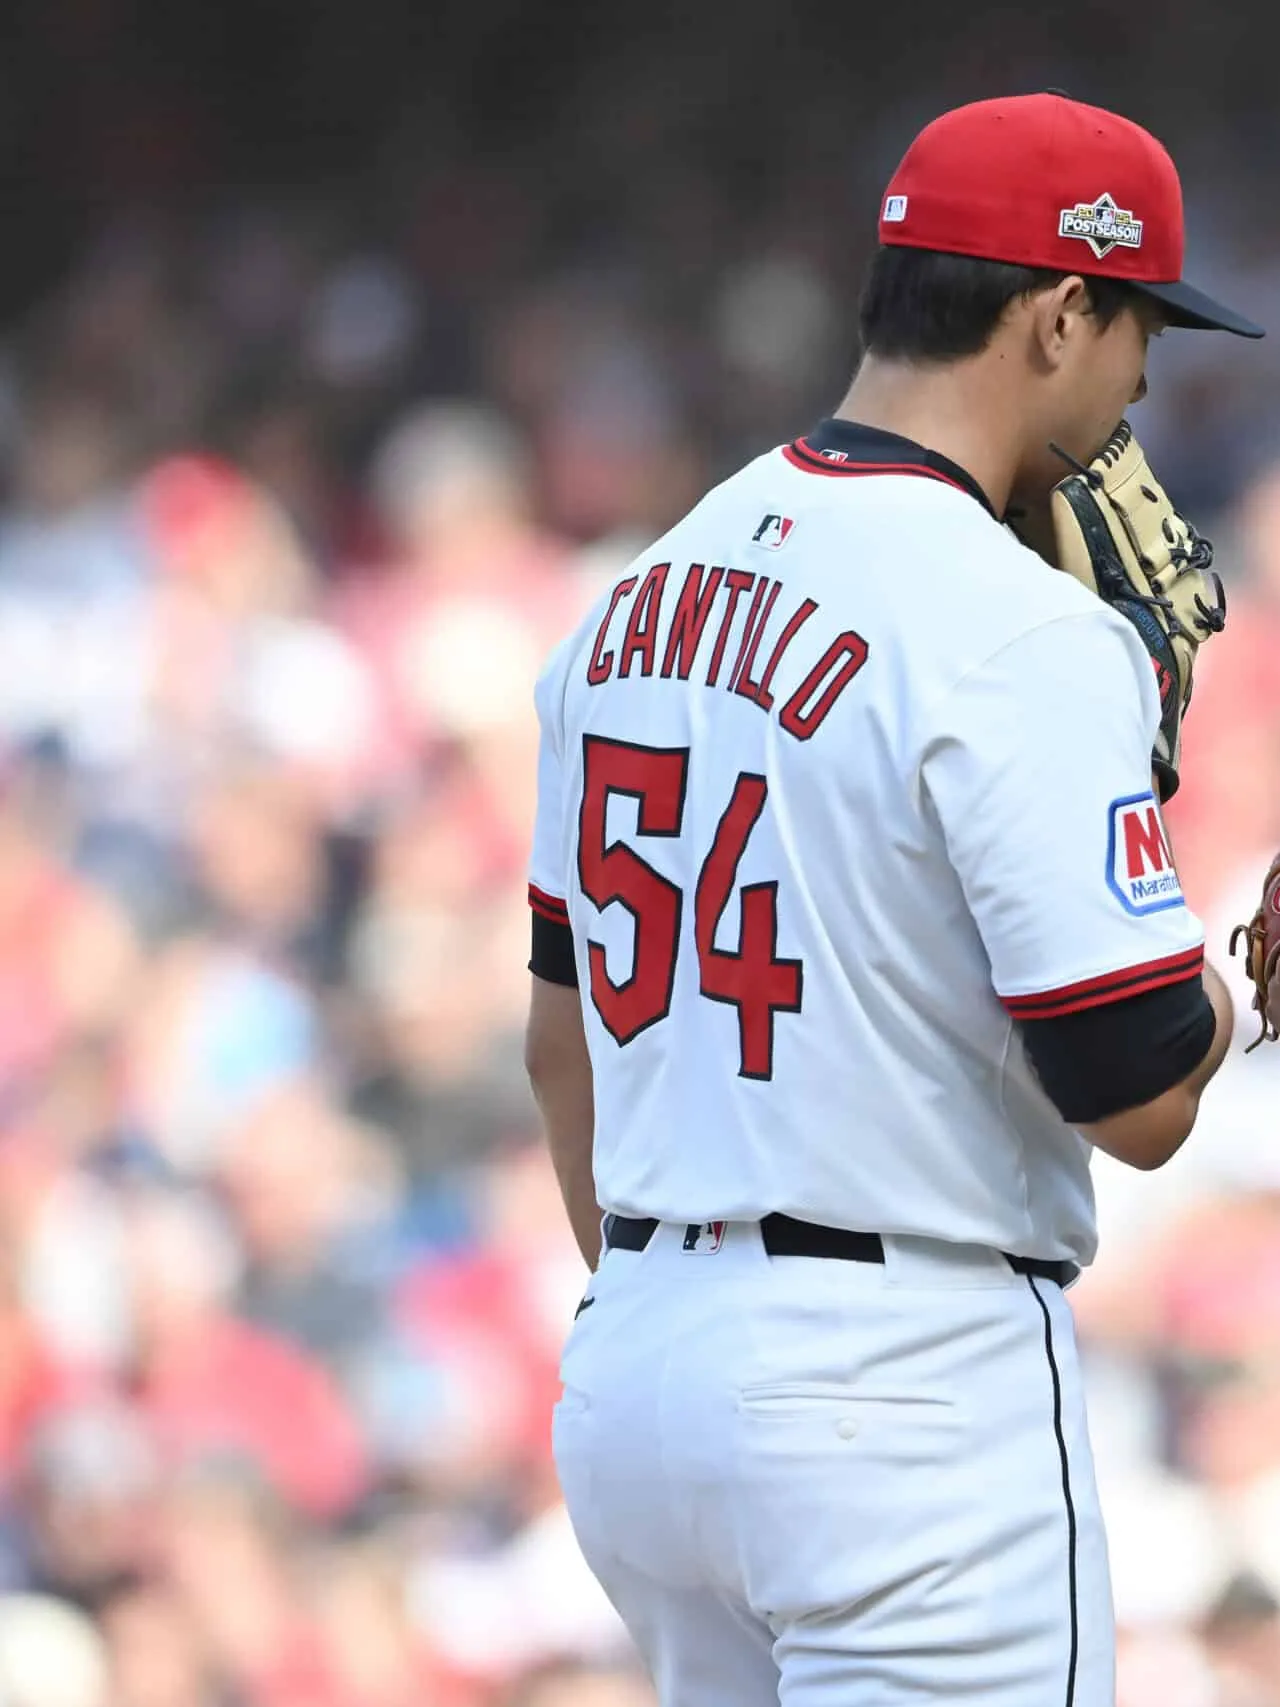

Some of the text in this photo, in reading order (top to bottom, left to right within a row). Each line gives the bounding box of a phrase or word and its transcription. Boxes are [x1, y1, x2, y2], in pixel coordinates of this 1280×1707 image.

[1064, 215, 1139, 241] POSTSEASON
[587, 562, 868, 741] CANTILLO
[1123, 807, 1174, 878] M
[577, 733, 804, 1082] 54
